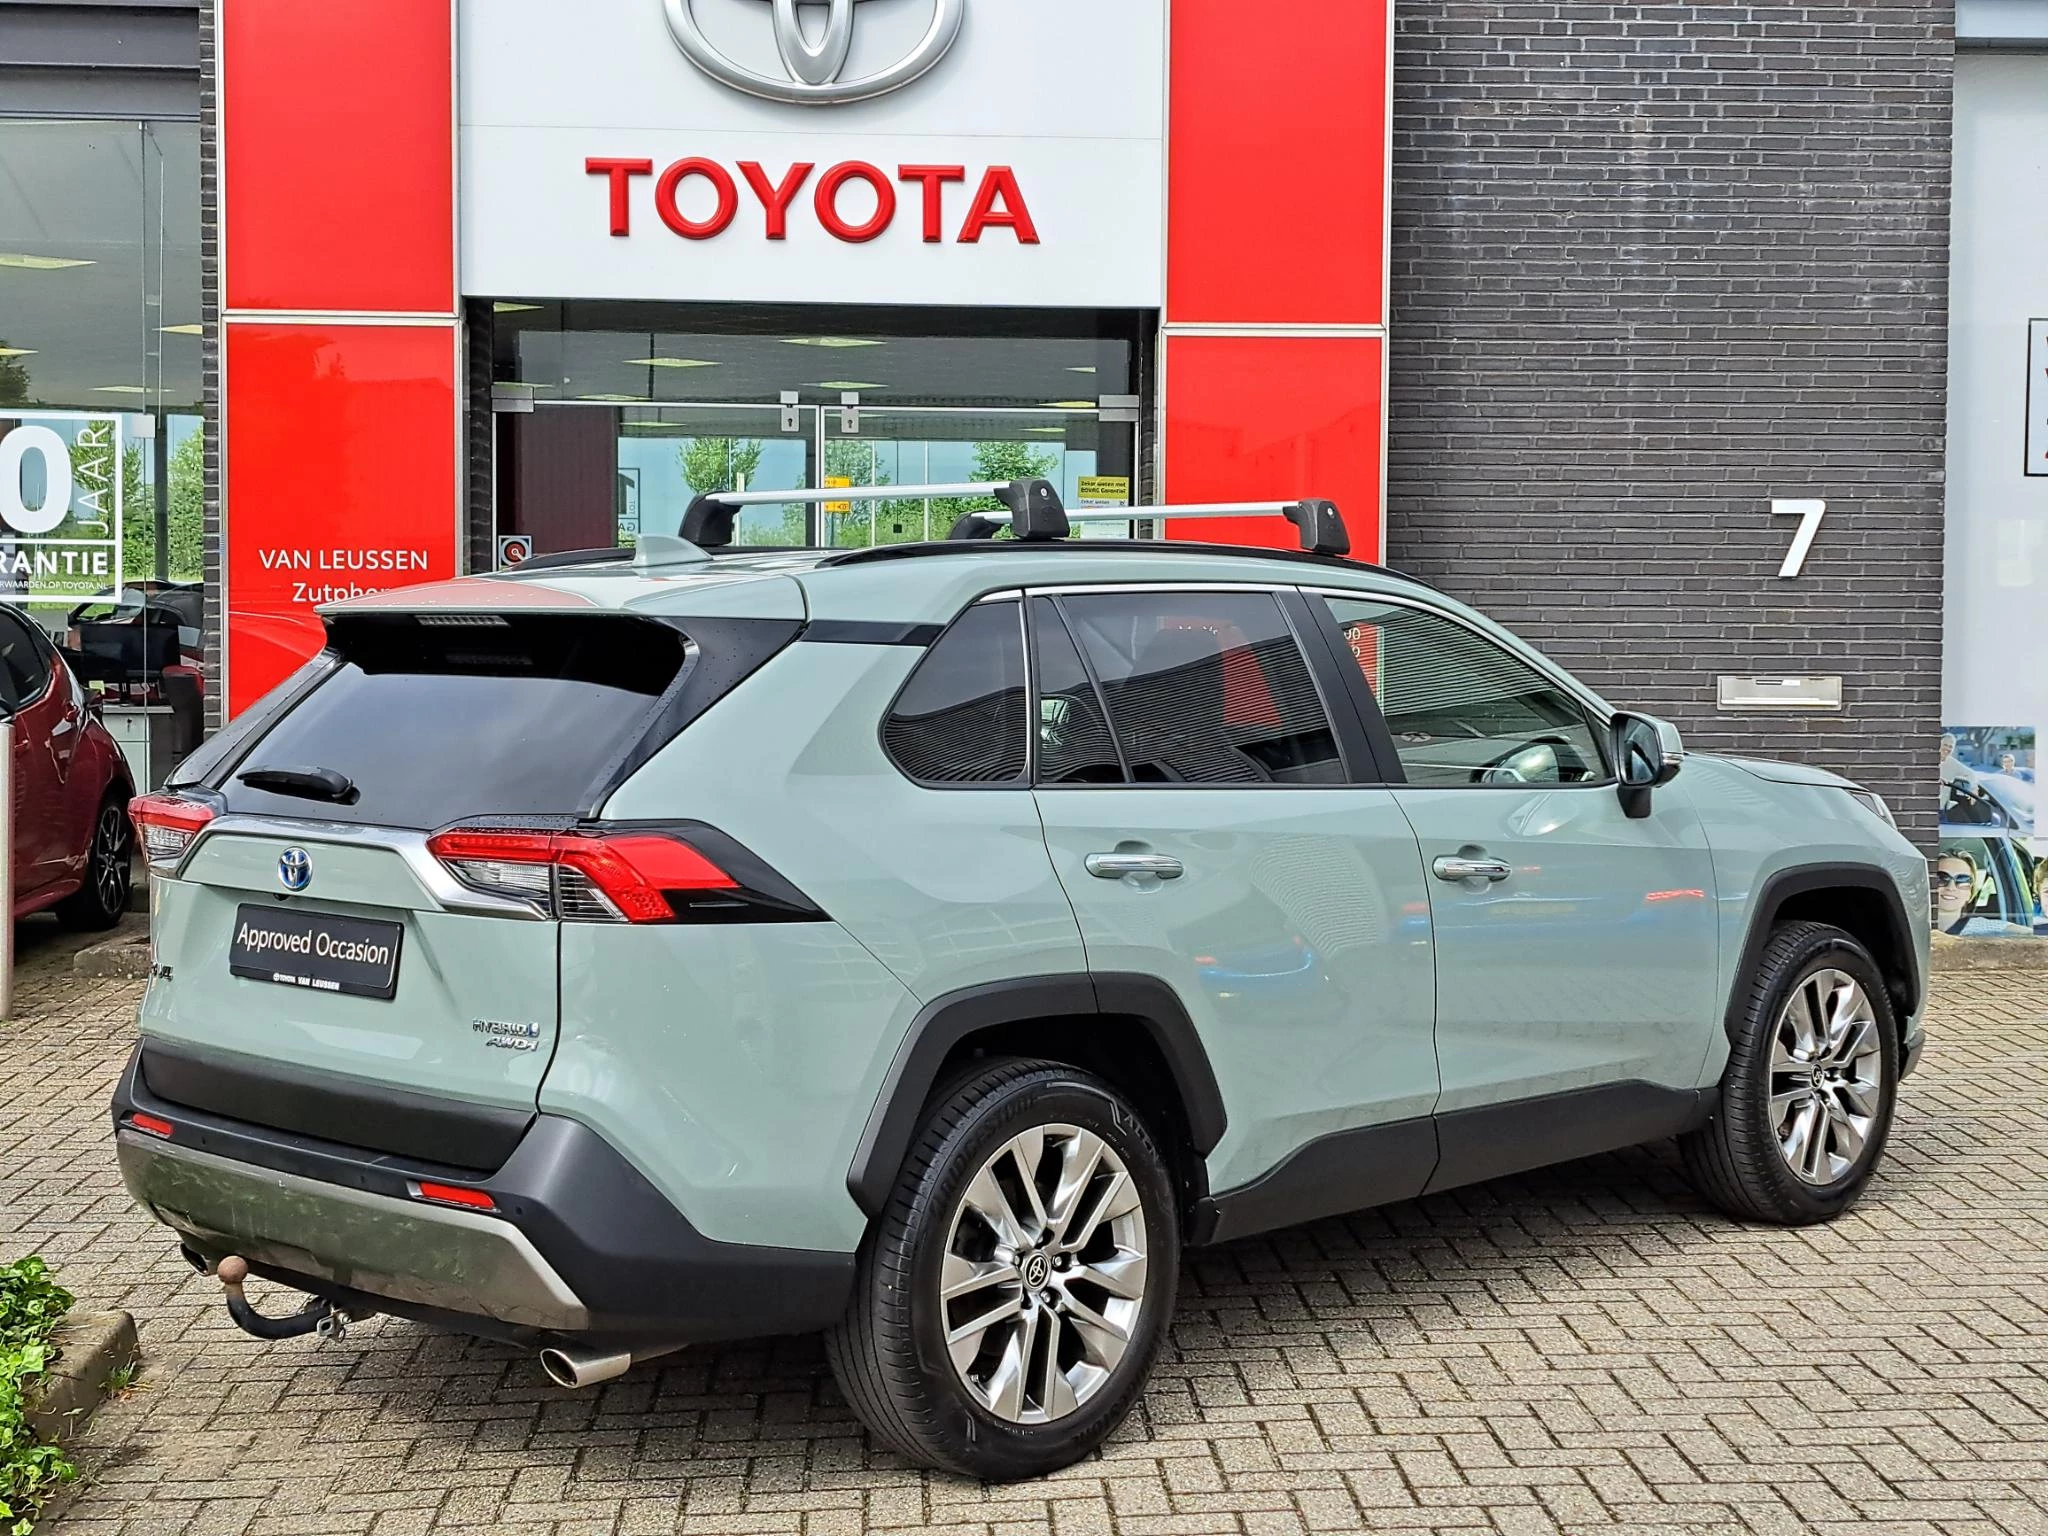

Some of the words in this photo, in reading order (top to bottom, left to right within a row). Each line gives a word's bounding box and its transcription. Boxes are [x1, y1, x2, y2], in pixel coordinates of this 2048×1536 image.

[585, 156, 1040, 244] TOYOTA
[77, 425, 109, 534] JAAR
[258, 549, 311, 569] VAN
[319, 549, 428, 570] LEUSSEN
[1772, 499, 1826, 577] 7
[236, 922, 312, 954] Approved
[316, 932, 389, 965] Occasion
[298, 976, 311, 986] VAN
[312, 979, 340, 991] LEUSSEN
[472, 1018, 527, 1038] HYBRID
